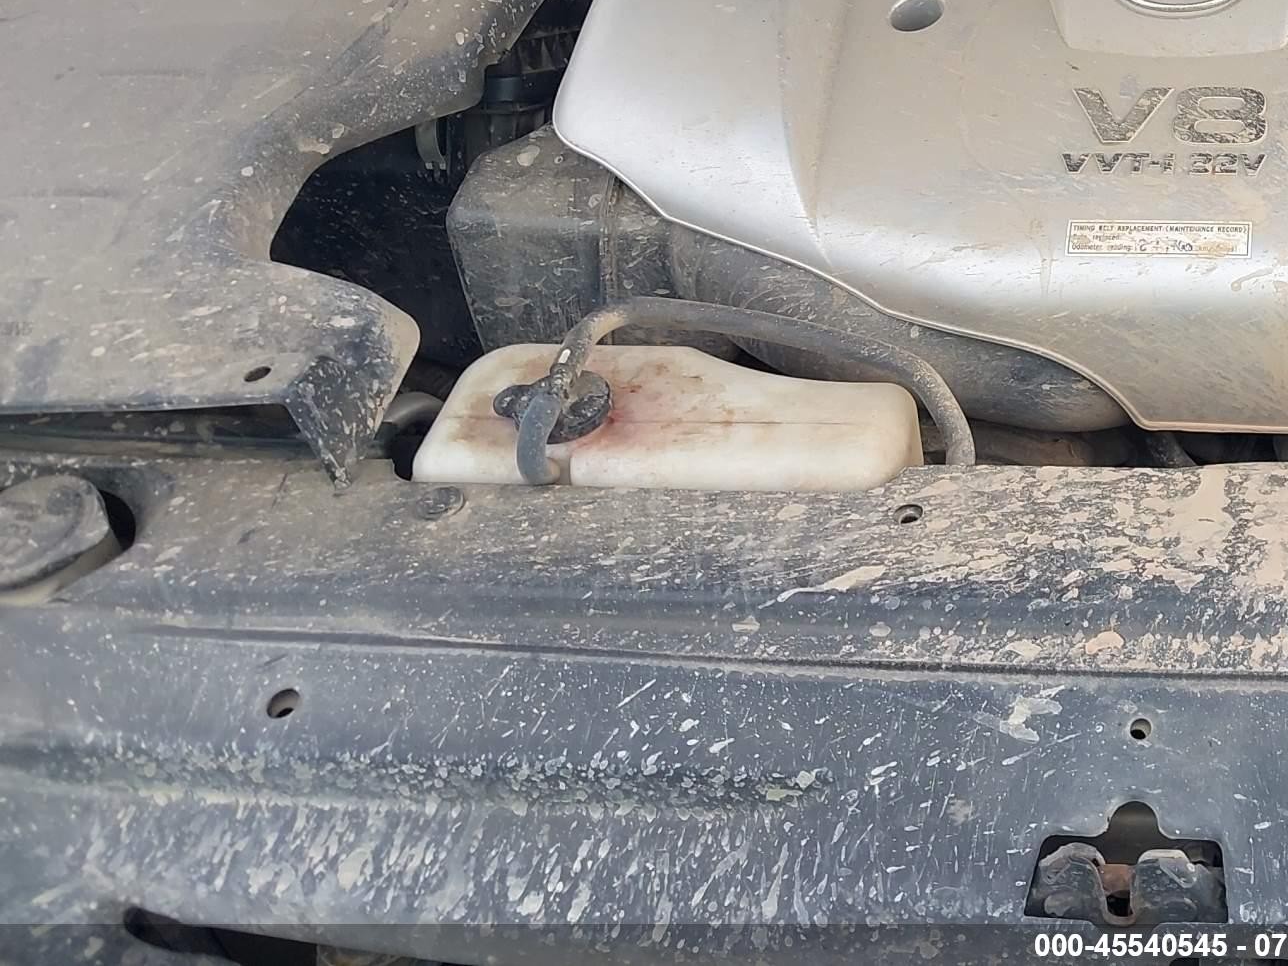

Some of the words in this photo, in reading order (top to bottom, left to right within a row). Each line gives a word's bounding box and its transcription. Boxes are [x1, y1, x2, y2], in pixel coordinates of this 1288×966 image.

[1072, 86, 1268, 145] V8
[1073, 225, 1096, 233] TIMING
[1117, 225, 1163, 233] REPLACEMENT
